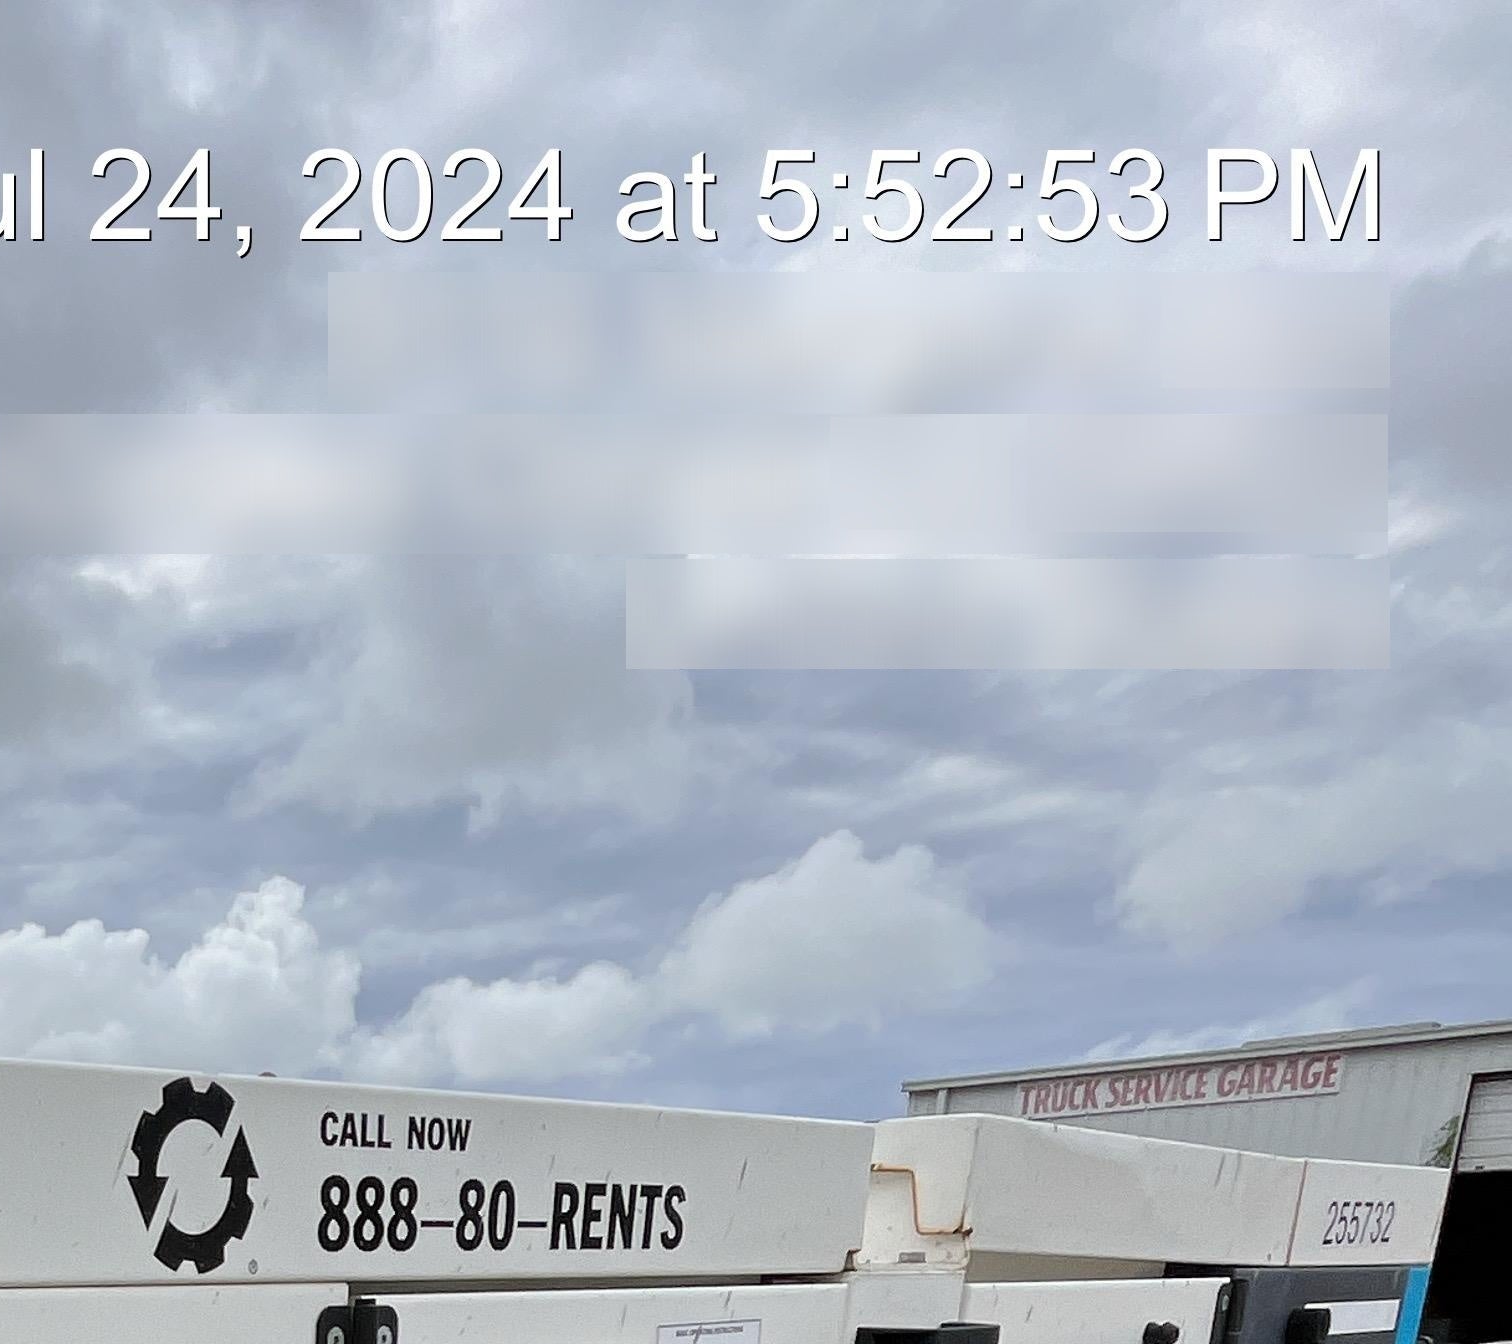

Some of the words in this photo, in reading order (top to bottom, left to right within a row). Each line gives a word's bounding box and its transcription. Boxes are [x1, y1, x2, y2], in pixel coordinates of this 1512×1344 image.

[1019, 1076, 1102, 1116] TRUCK
[1105, 1065, 1210, 1109] SERVICE
[1216, 1053, 1343, 1097] GARAGE
[319, 1110, 392, 1150] CALL
[406, 1115, 472, 1153] NOW
[317, 1173, 687, 1253] 888-80-RENTS
[1321, 1200, 1396, 1246] 255732
